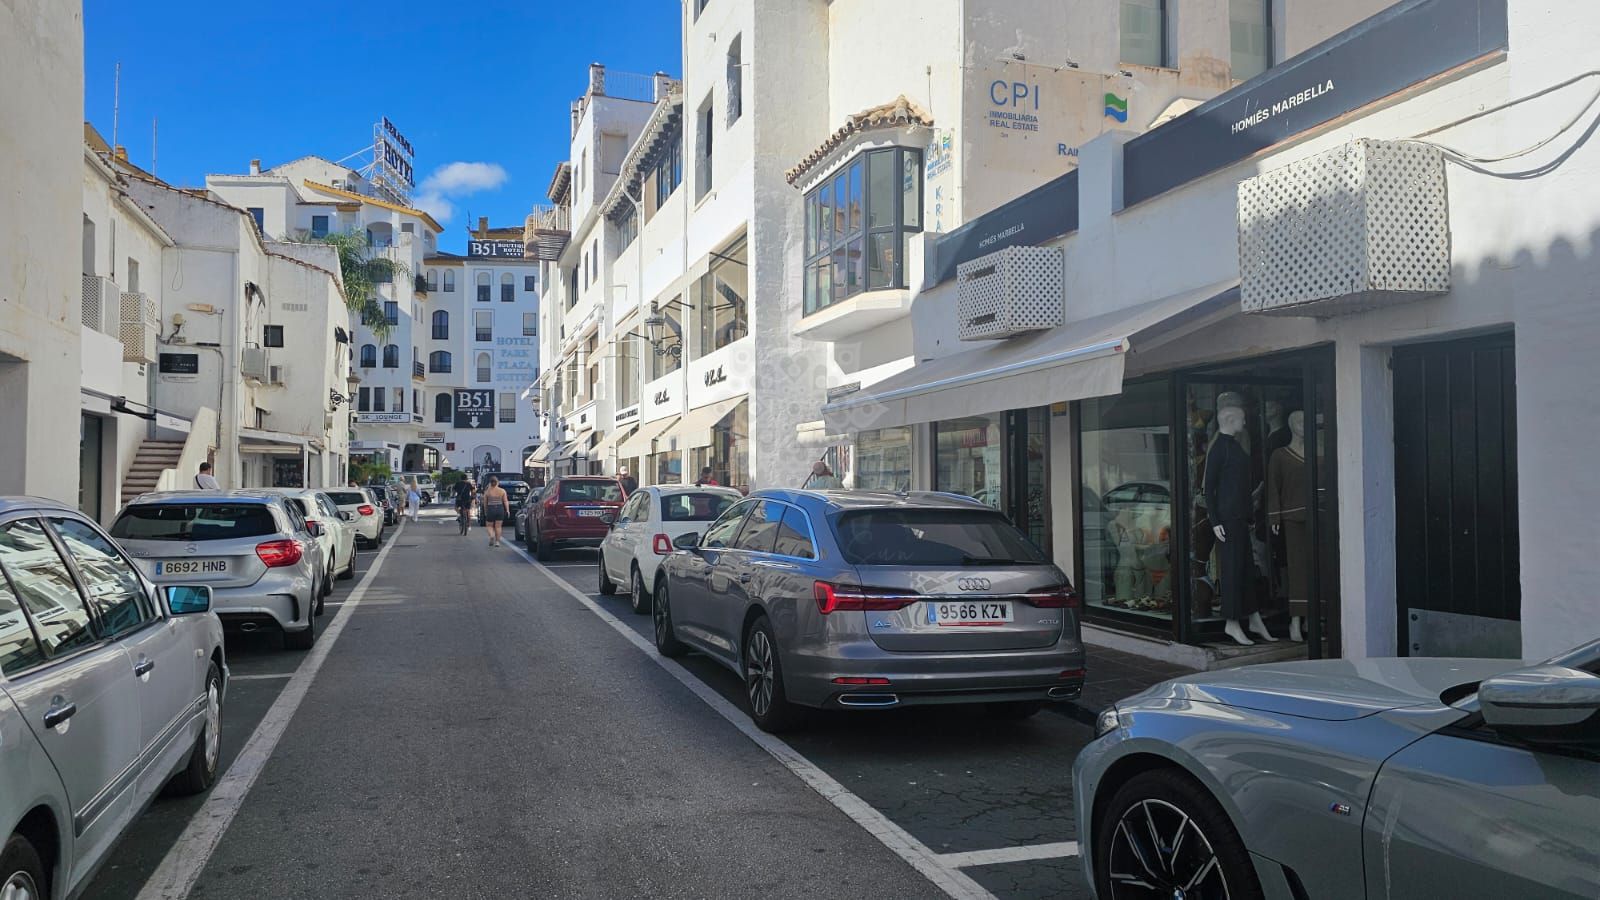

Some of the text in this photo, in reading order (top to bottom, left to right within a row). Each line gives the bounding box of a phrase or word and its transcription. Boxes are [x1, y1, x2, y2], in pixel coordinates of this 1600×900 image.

[990, 80, 1039, 110] CPI
[1272, 79, 1334, 116] MARBELLA
[989, 110, 1039, 123] INMOBILIARIA
[989, 119, 1039, 132] REAL ESTATE
[384, 140, 416, 188] HOTEL
[471, 242, 497, 256] B51
[497, 337, 534, 345] HOTEL
[457, 392, 491, 408] B51
[165, 560, 227, 574] 6692 HNB
[940, 604, 1007, 619] 9566 KZW
